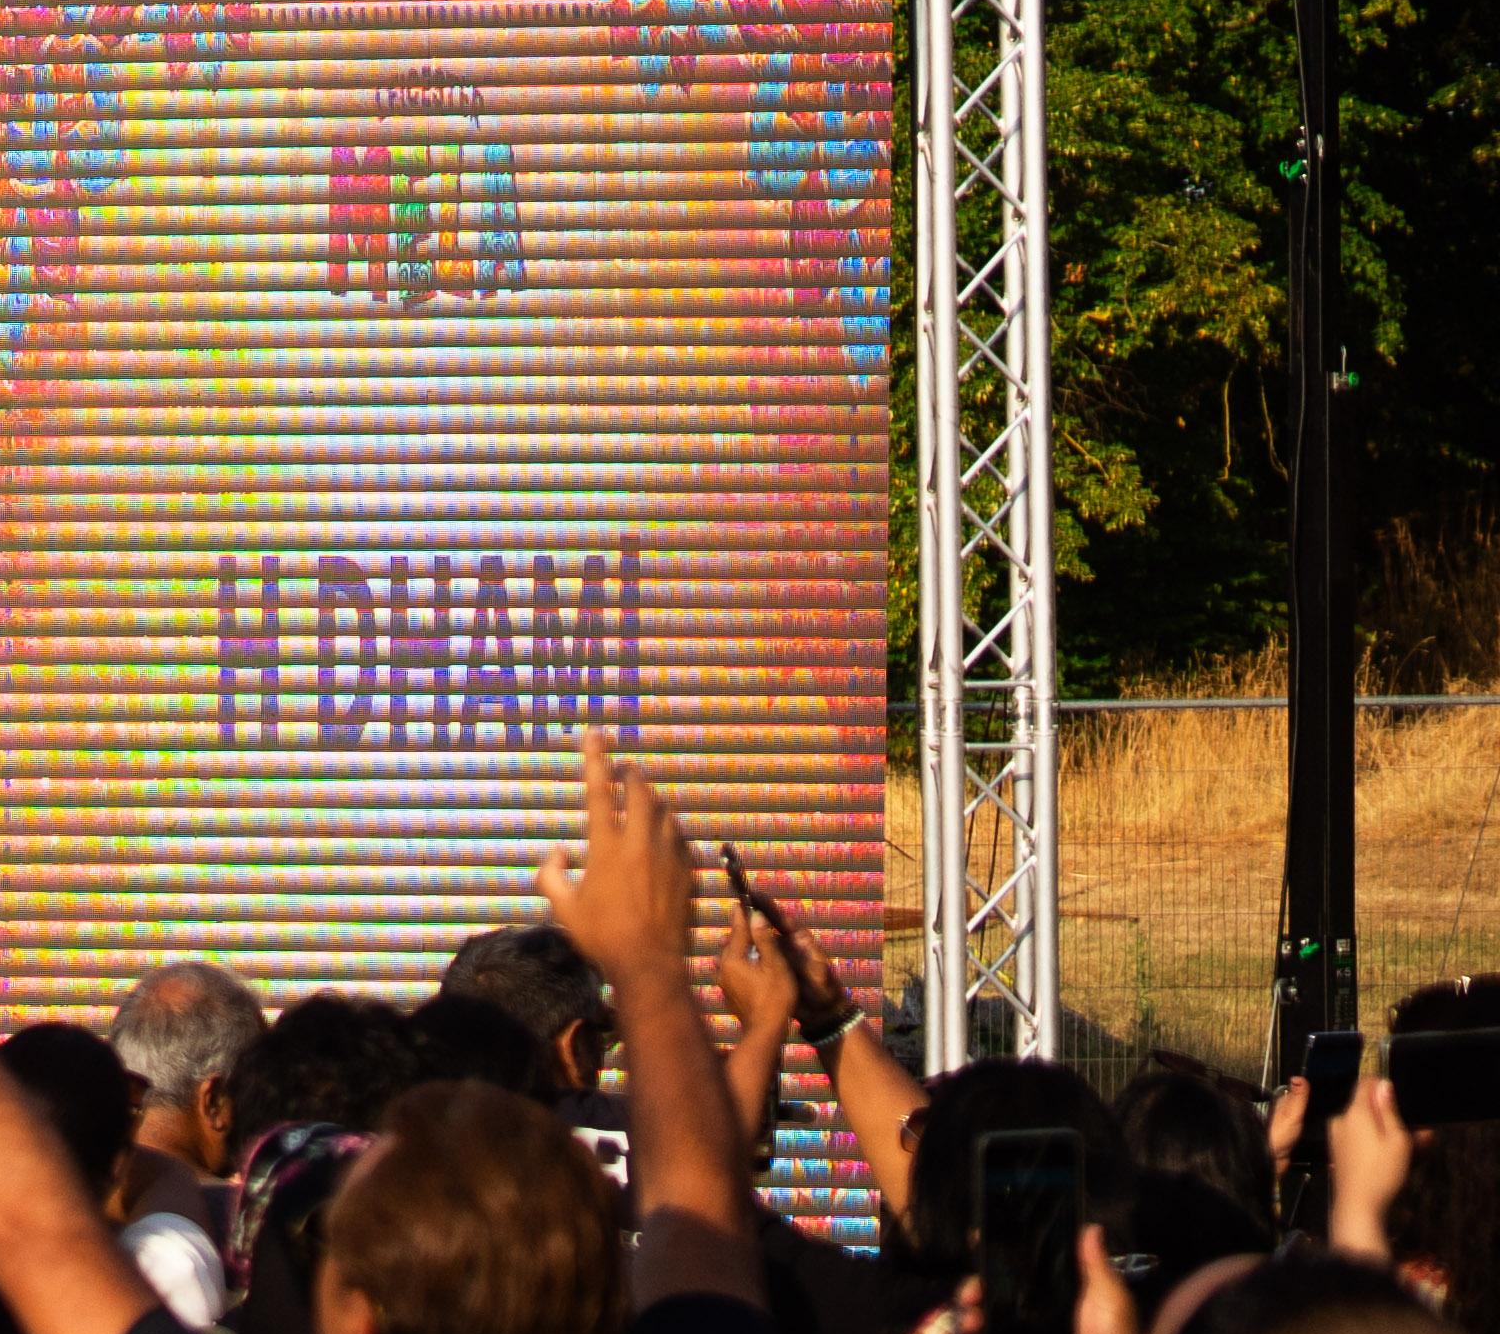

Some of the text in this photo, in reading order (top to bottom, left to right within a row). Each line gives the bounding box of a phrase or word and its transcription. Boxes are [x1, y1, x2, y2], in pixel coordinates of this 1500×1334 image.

[327, 145, 526, 304] MELA
[219, 535, 641, 747] H DHAMI
